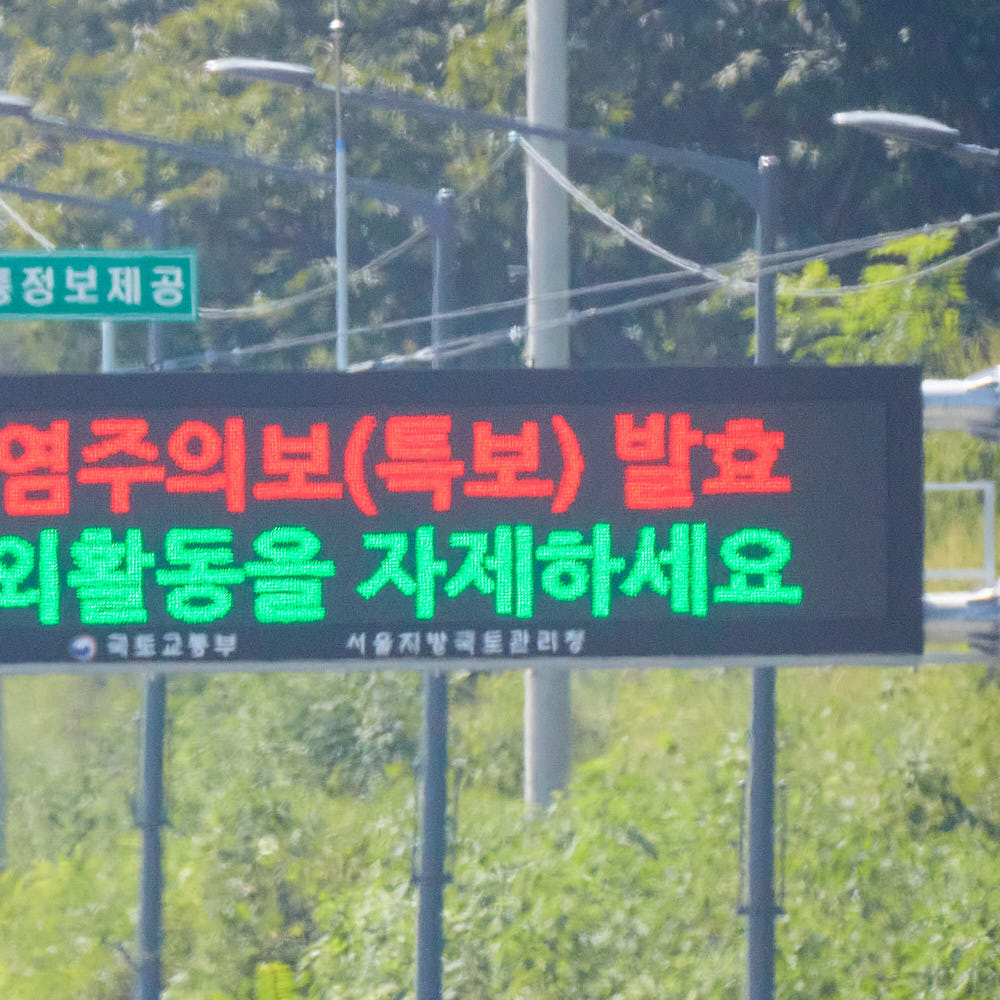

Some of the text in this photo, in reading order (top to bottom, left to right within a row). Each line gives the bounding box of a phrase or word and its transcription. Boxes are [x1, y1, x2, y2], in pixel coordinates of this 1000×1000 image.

[613, 412, 793, 510] 발효
[355, 521, 804, 620] 자제하세요
[106, 631, 239, 659] 국토교통부
